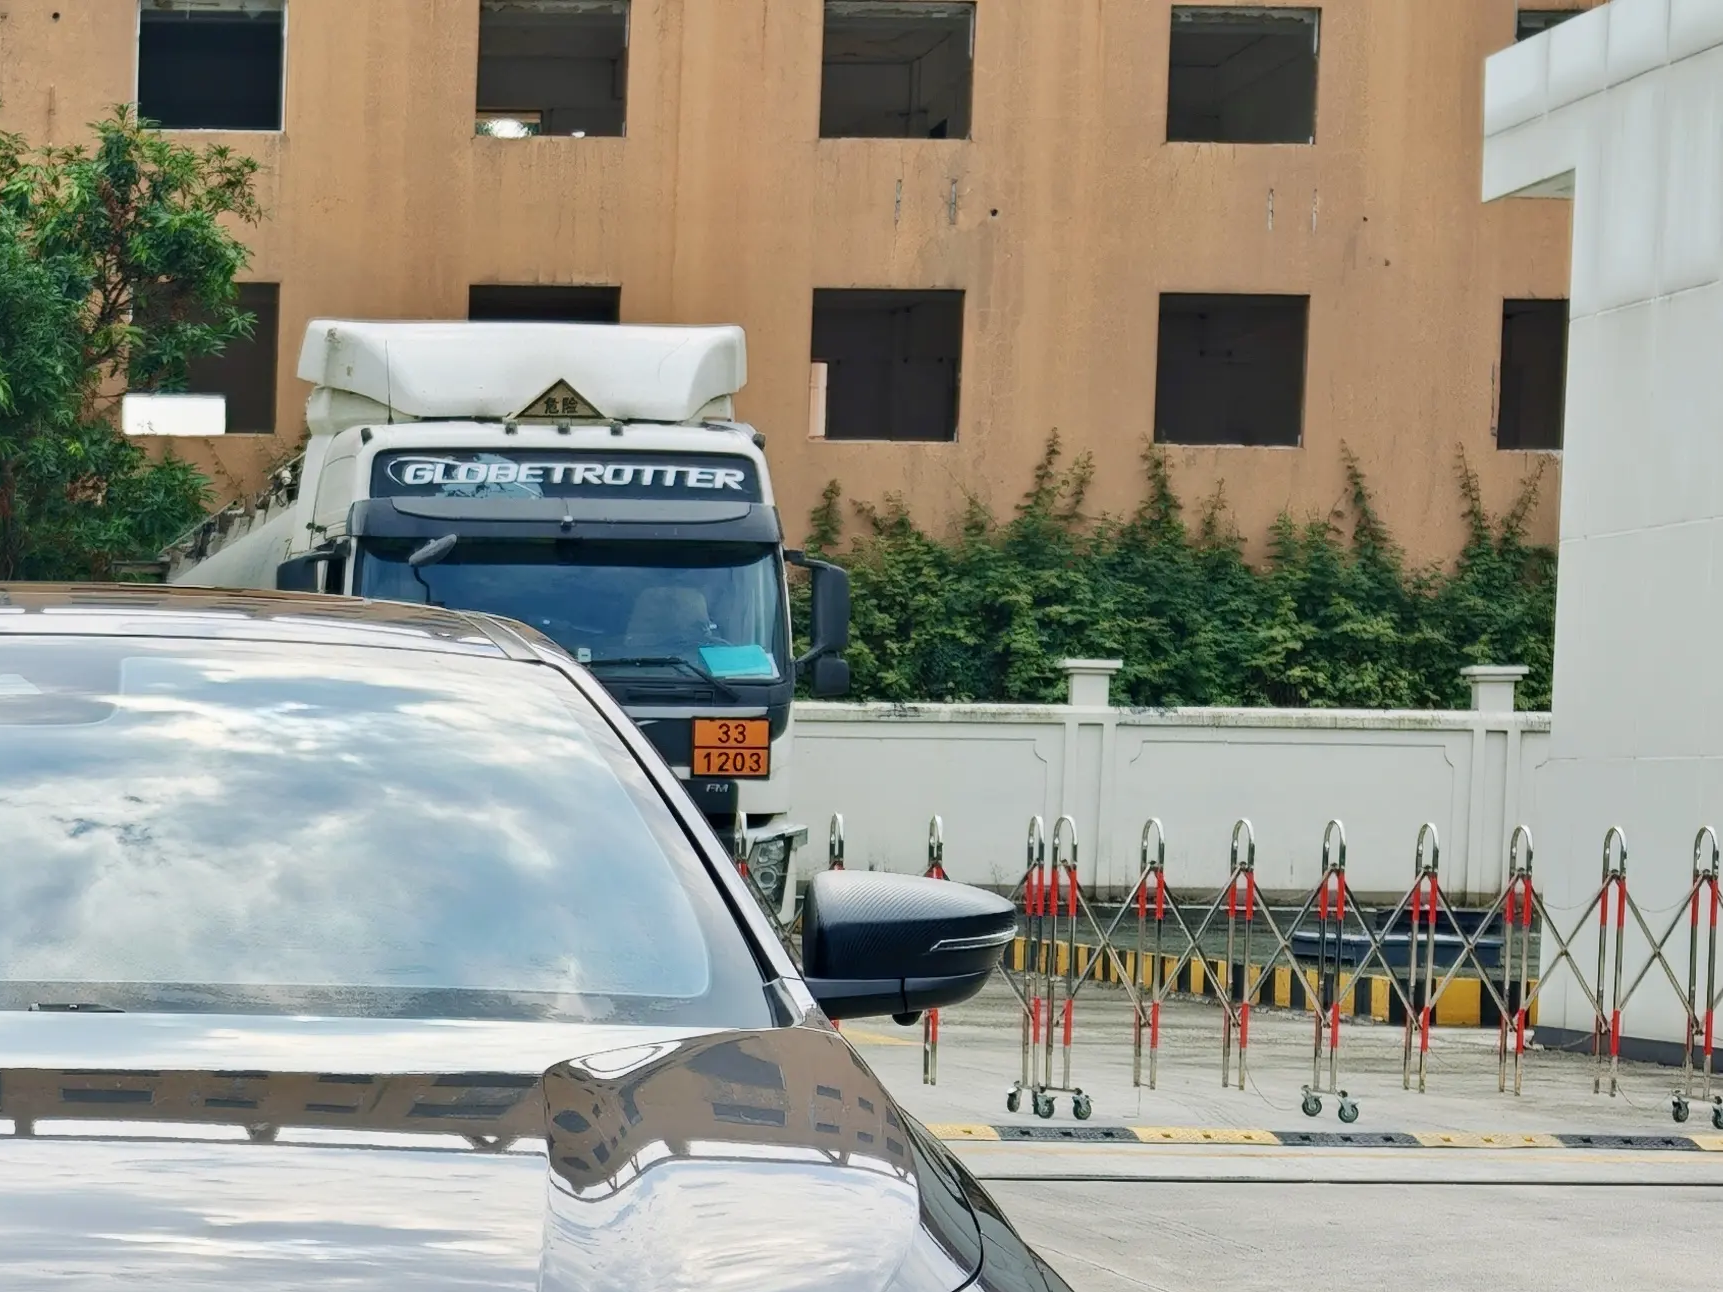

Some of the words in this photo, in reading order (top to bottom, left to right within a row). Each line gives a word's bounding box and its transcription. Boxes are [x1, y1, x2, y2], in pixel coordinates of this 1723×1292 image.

[543, 396, 578, 414] 危险
[403, 462, 745, 491] GLOBETROTTER
[718, 723, 746, 744] 33
[703, 751, 761, 772] 1203
[706, 783, 729, 793] FM
